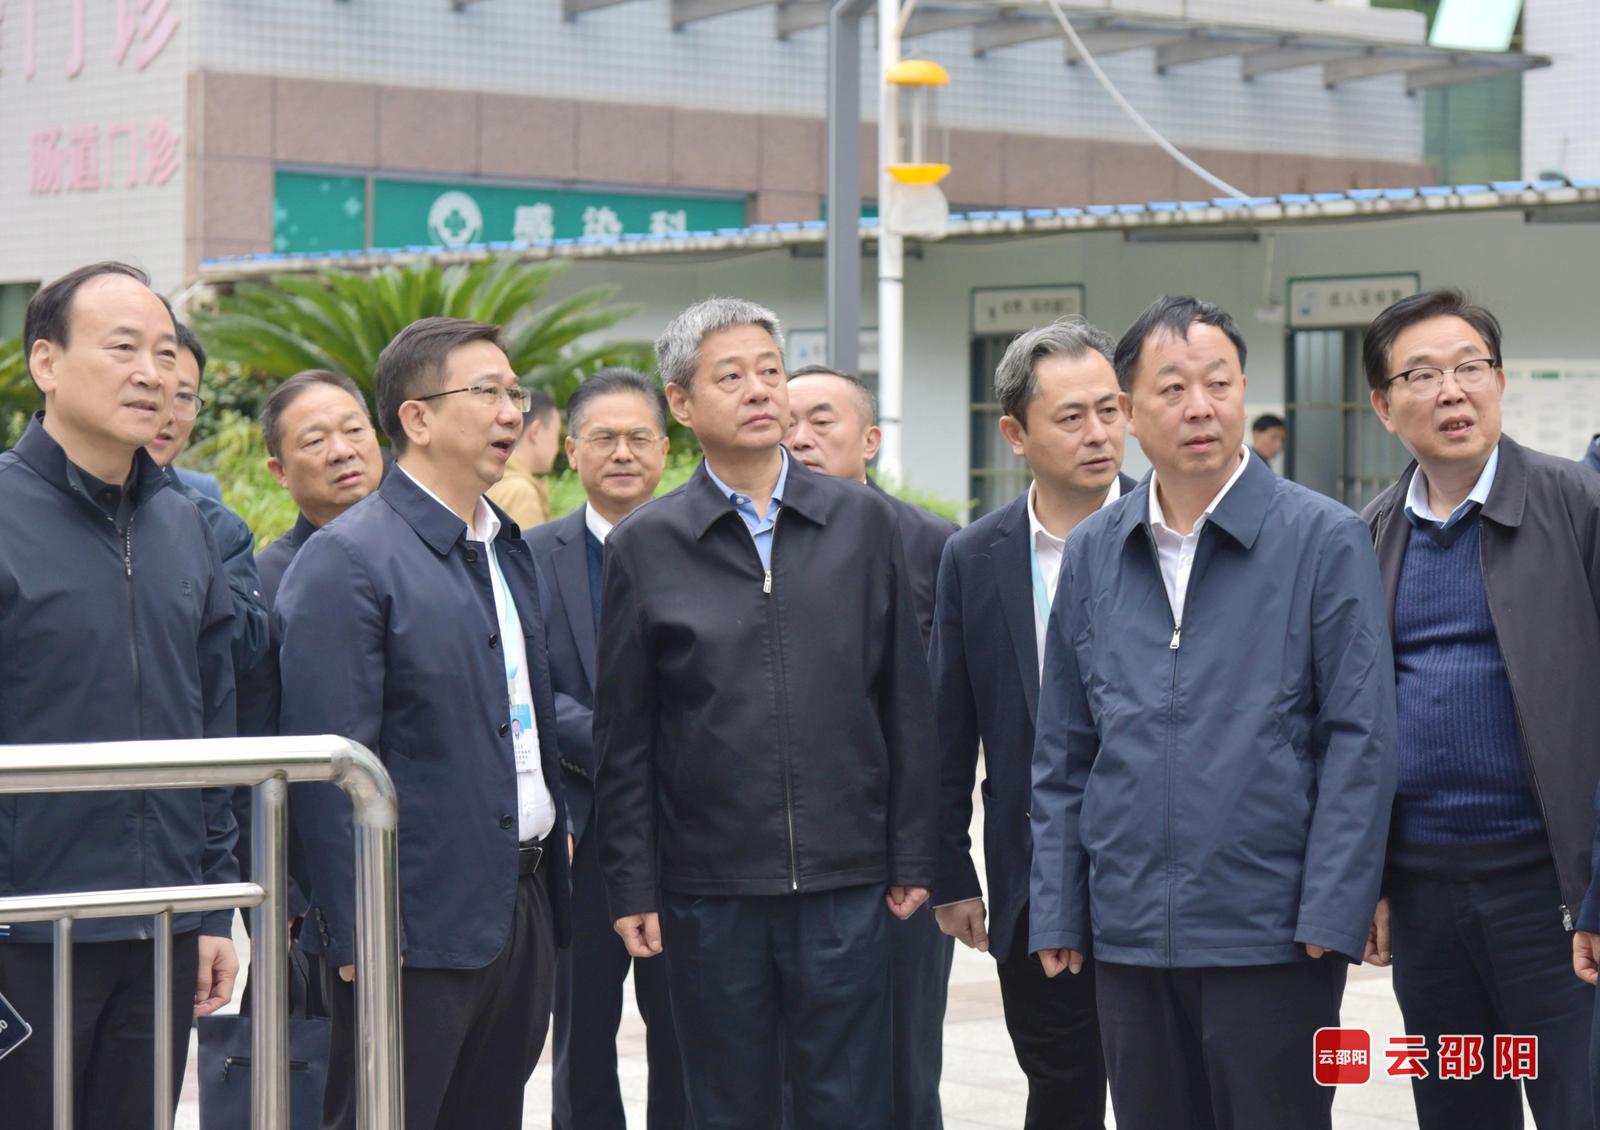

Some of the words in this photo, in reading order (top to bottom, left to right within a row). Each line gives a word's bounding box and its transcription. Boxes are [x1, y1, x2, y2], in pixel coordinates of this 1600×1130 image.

[30, 115, 181, 194] 肠道门诊
[512, 202, 687, 242] 感染科
